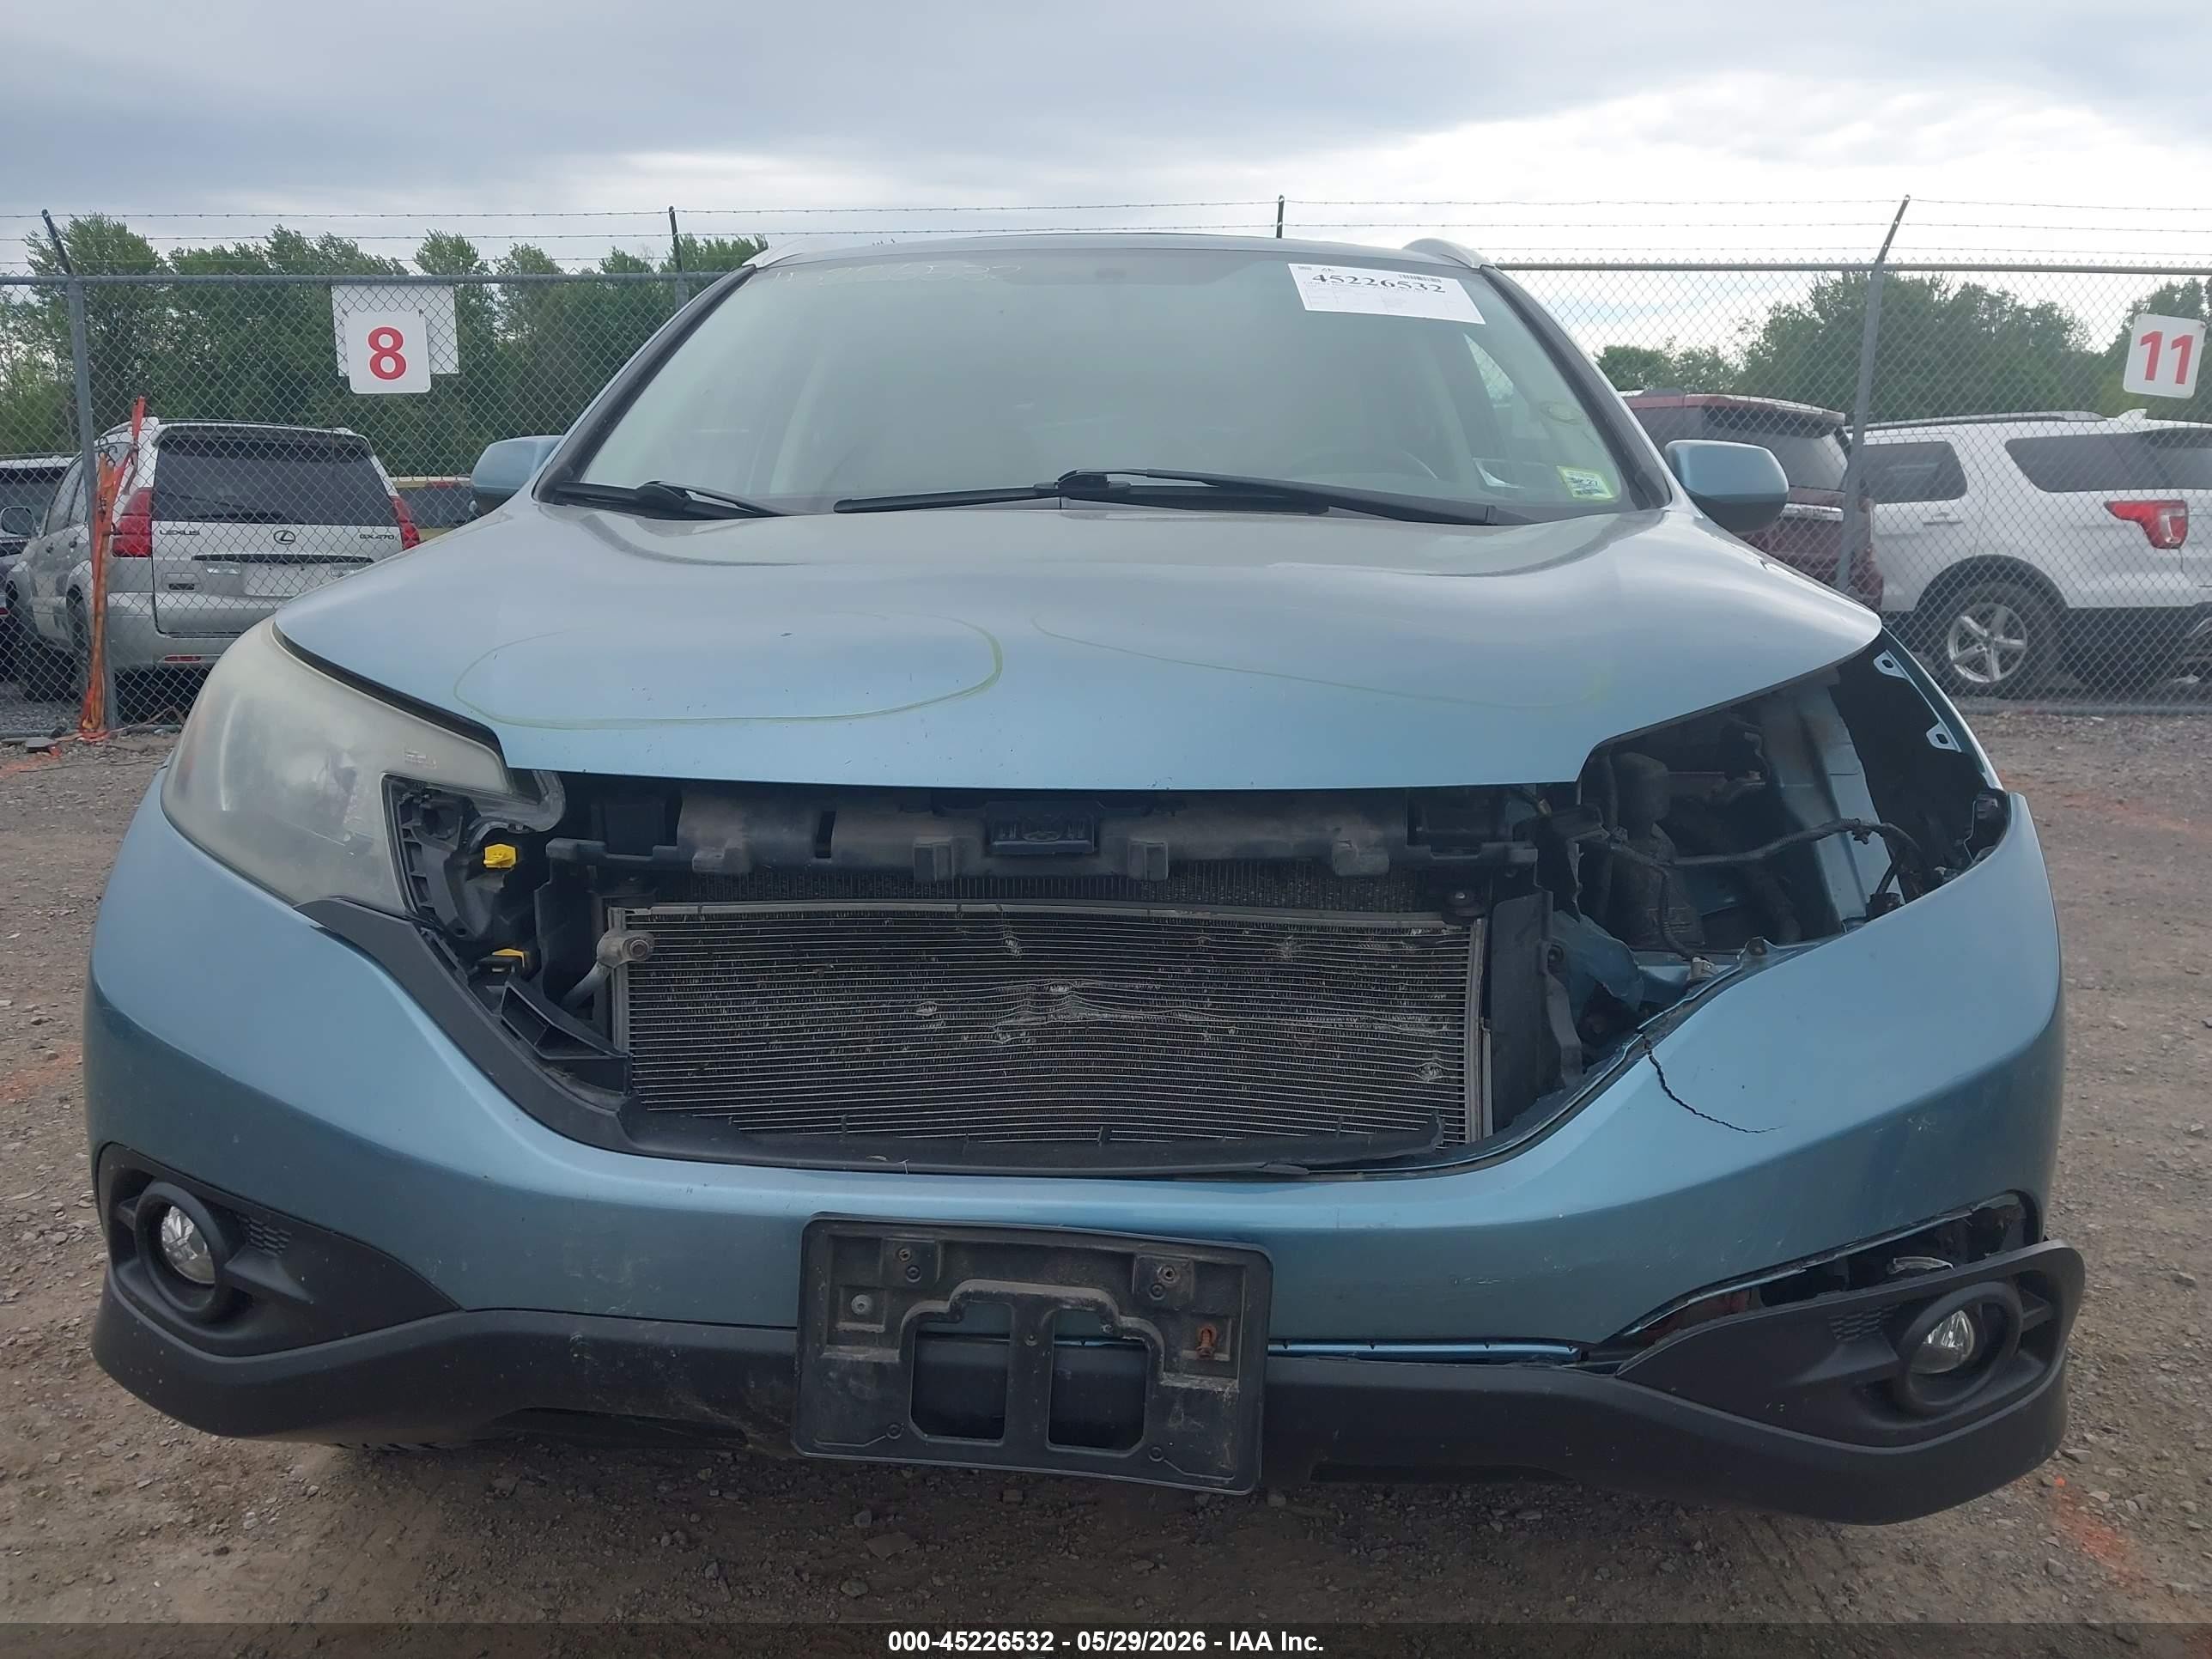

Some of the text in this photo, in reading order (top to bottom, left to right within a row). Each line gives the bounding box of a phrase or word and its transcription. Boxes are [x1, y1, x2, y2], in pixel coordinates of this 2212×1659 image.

[1312, 274, 1446, 294] 45226532
[368, 326, 407, 380] 8
[2139, 331, 2194, 385] 11
